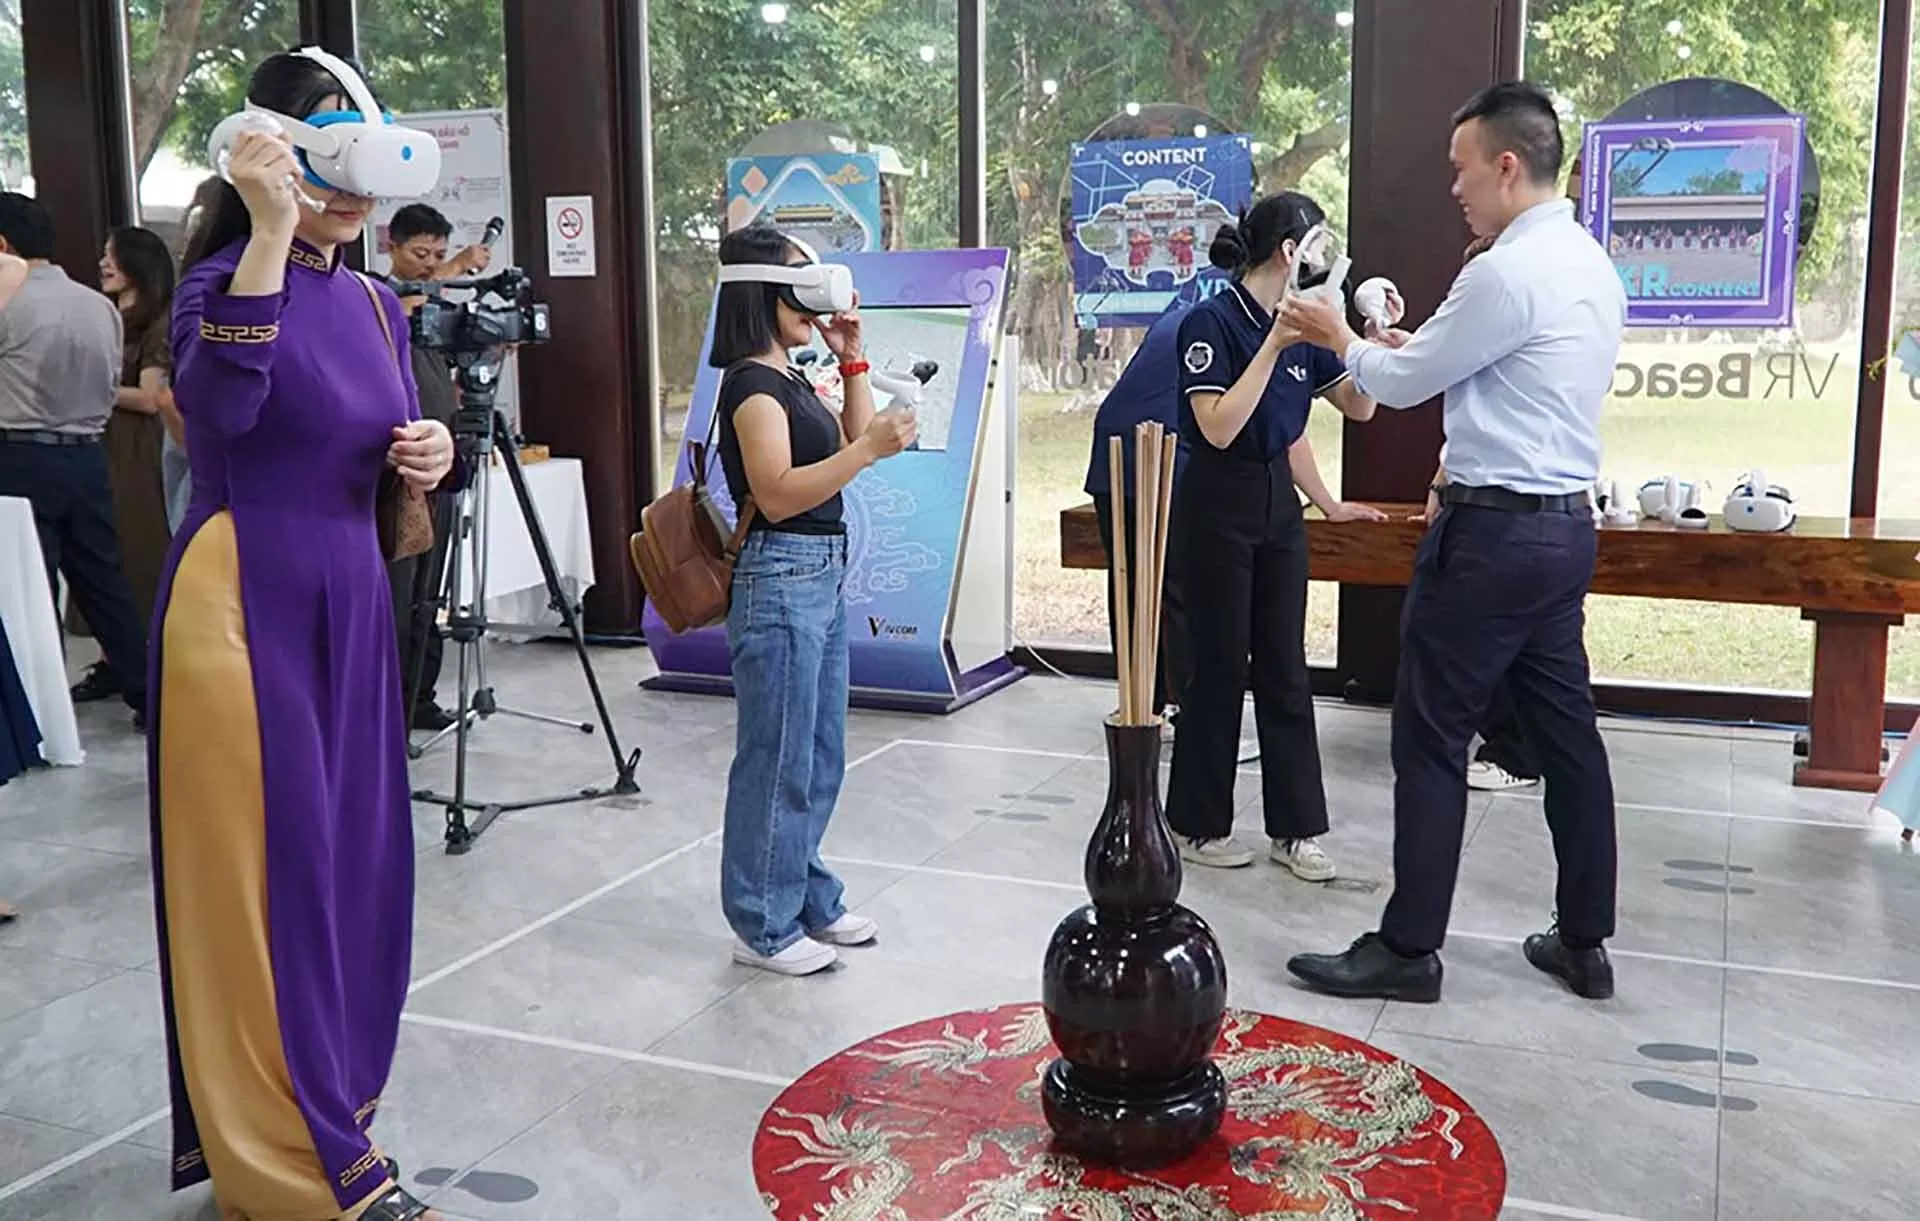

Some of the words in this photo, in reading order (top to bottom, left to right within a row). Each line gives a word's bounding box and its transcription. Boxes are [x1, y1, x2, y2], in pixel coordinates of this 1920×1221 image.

[1122, 147, 1207, 166] CONTENT
[1670, 281, 1761, 297] CONTENT
[534, 313, 547, 332] 6
